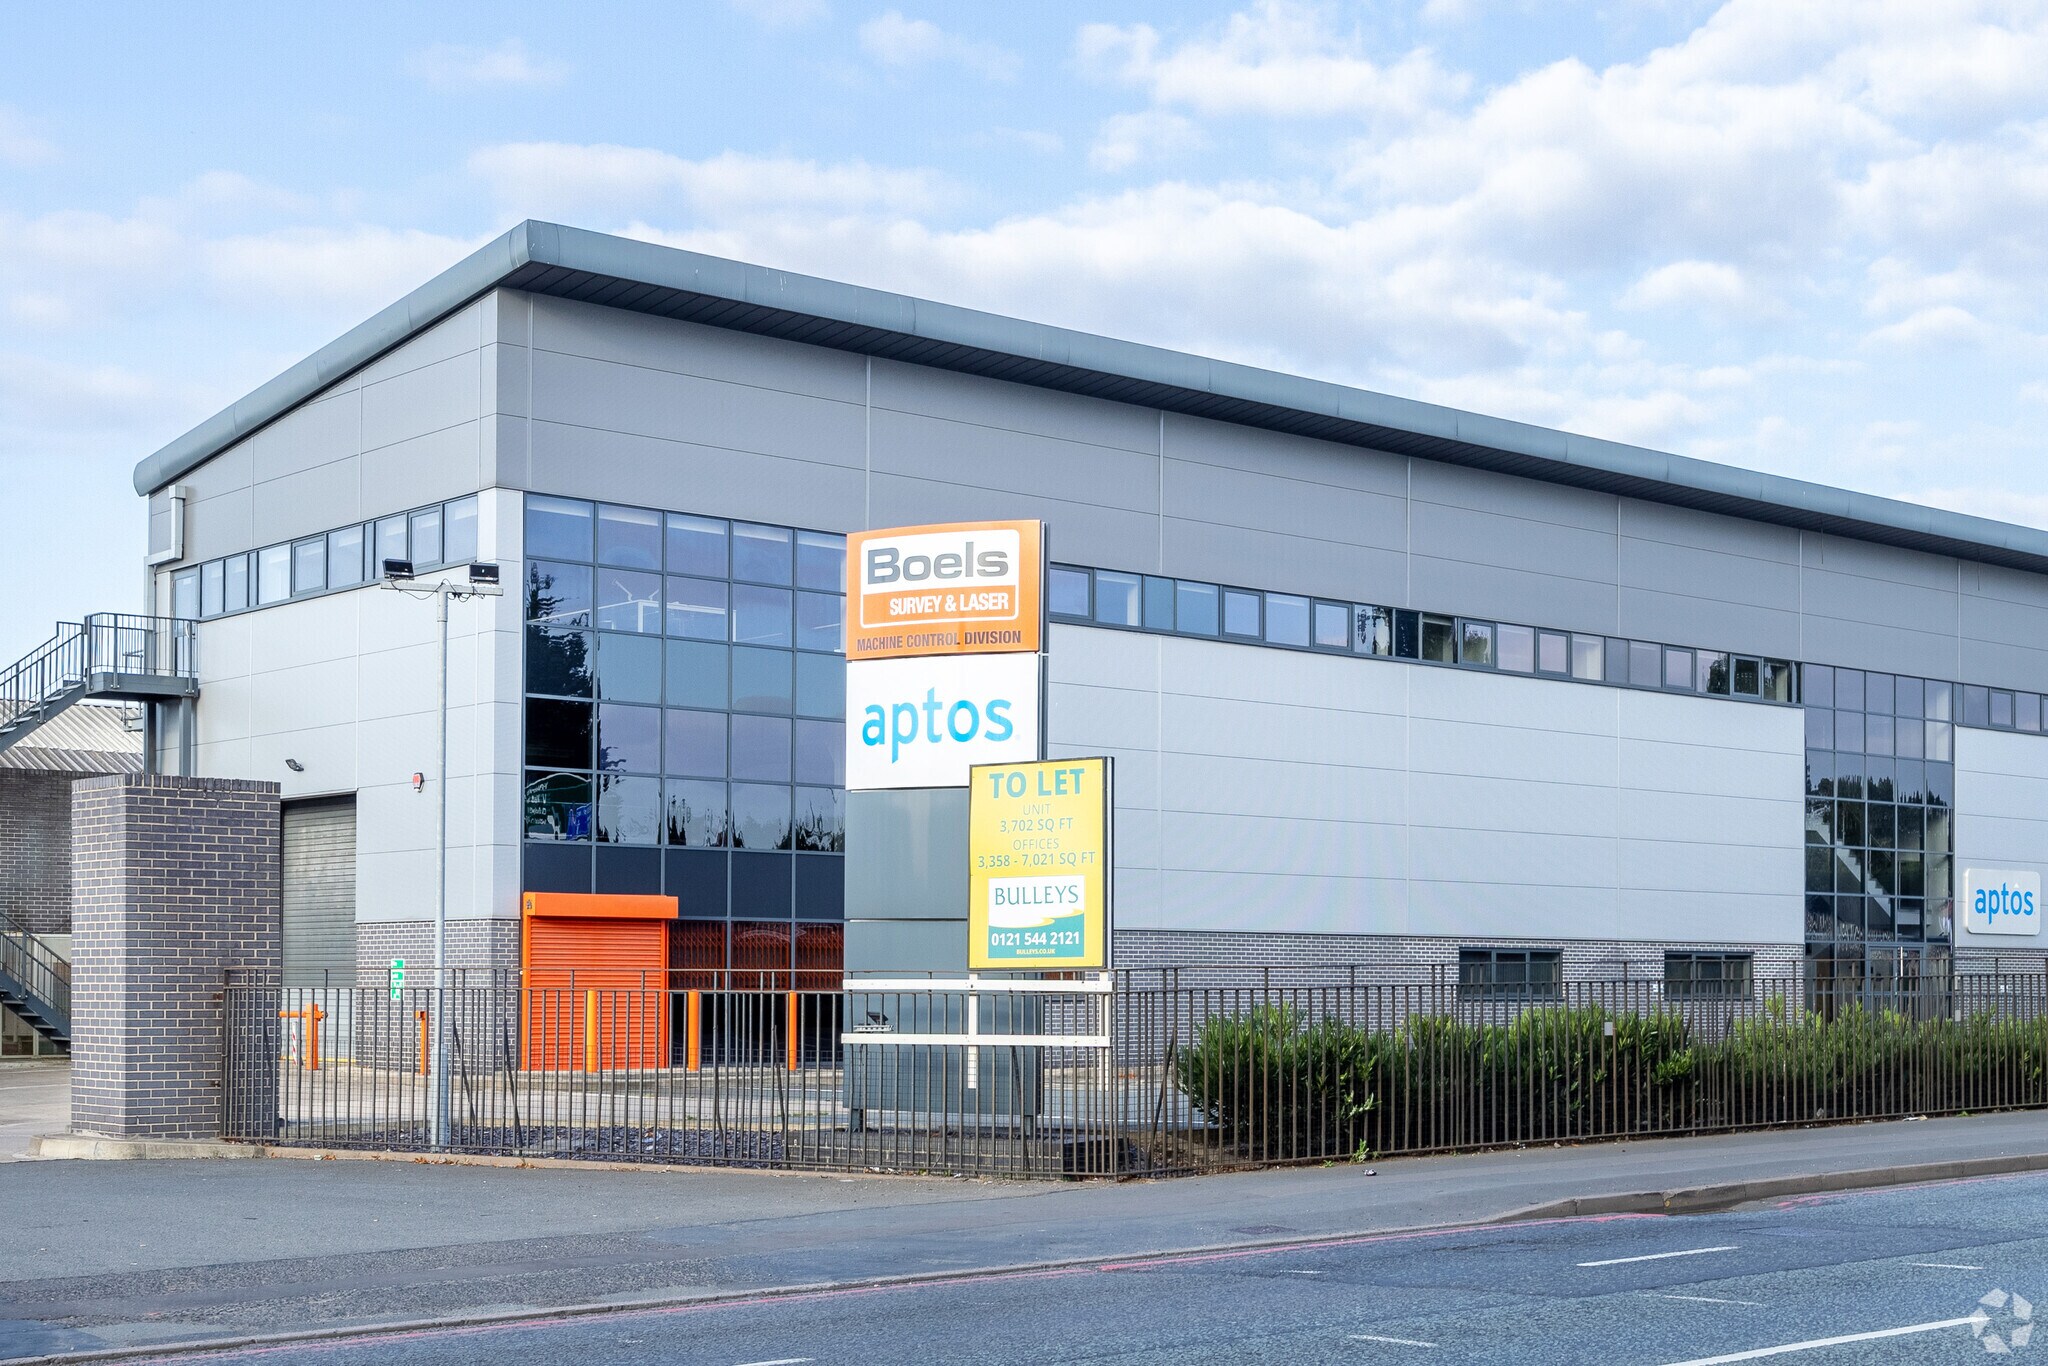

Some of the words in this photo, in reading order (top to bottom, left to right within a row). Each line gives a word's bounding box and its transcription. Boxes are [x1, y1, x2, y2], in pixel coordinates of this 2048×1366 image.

[867, 541, 1009, 585] Boels
[889, 594, 943, 616] SURVEY
[944, 594, 957, 612] &
[959, 592, 1009, 611] LASER
[857, 635, 903, 652] MACHINE
[906, 632, 960, 648] CONTROL
[964, 630, 1022, 645] DIVISION
[861, 686, 1014, 764] aptos
[989, 771, 1027, 799] TO
[1037, 768, 1086, 797] LET
[1023, 804, 1051, 816] UNIT
[1000, 819, 1033, 834] 3,702
[1037, 818, 1055, 833] SQ
[1059, 817, 1073, 830] FT
[1013, 838, 1060, 851] OFFICES
[978, 855, 1011, 869] 3,358
[1022, 853, 1054, 868] 7,021
[1059, 852, 1077, 867] SQ
[1081, 851, 1096, 864] FT
[994, 884, 1079, 906] BULLEYS
[1974, 882, 2034, 925] aptos
[991, 932, 1020, 946] 0121
[1024, 932, 1047, 946] 544
[1050, 931, 1080, 945] 2121
